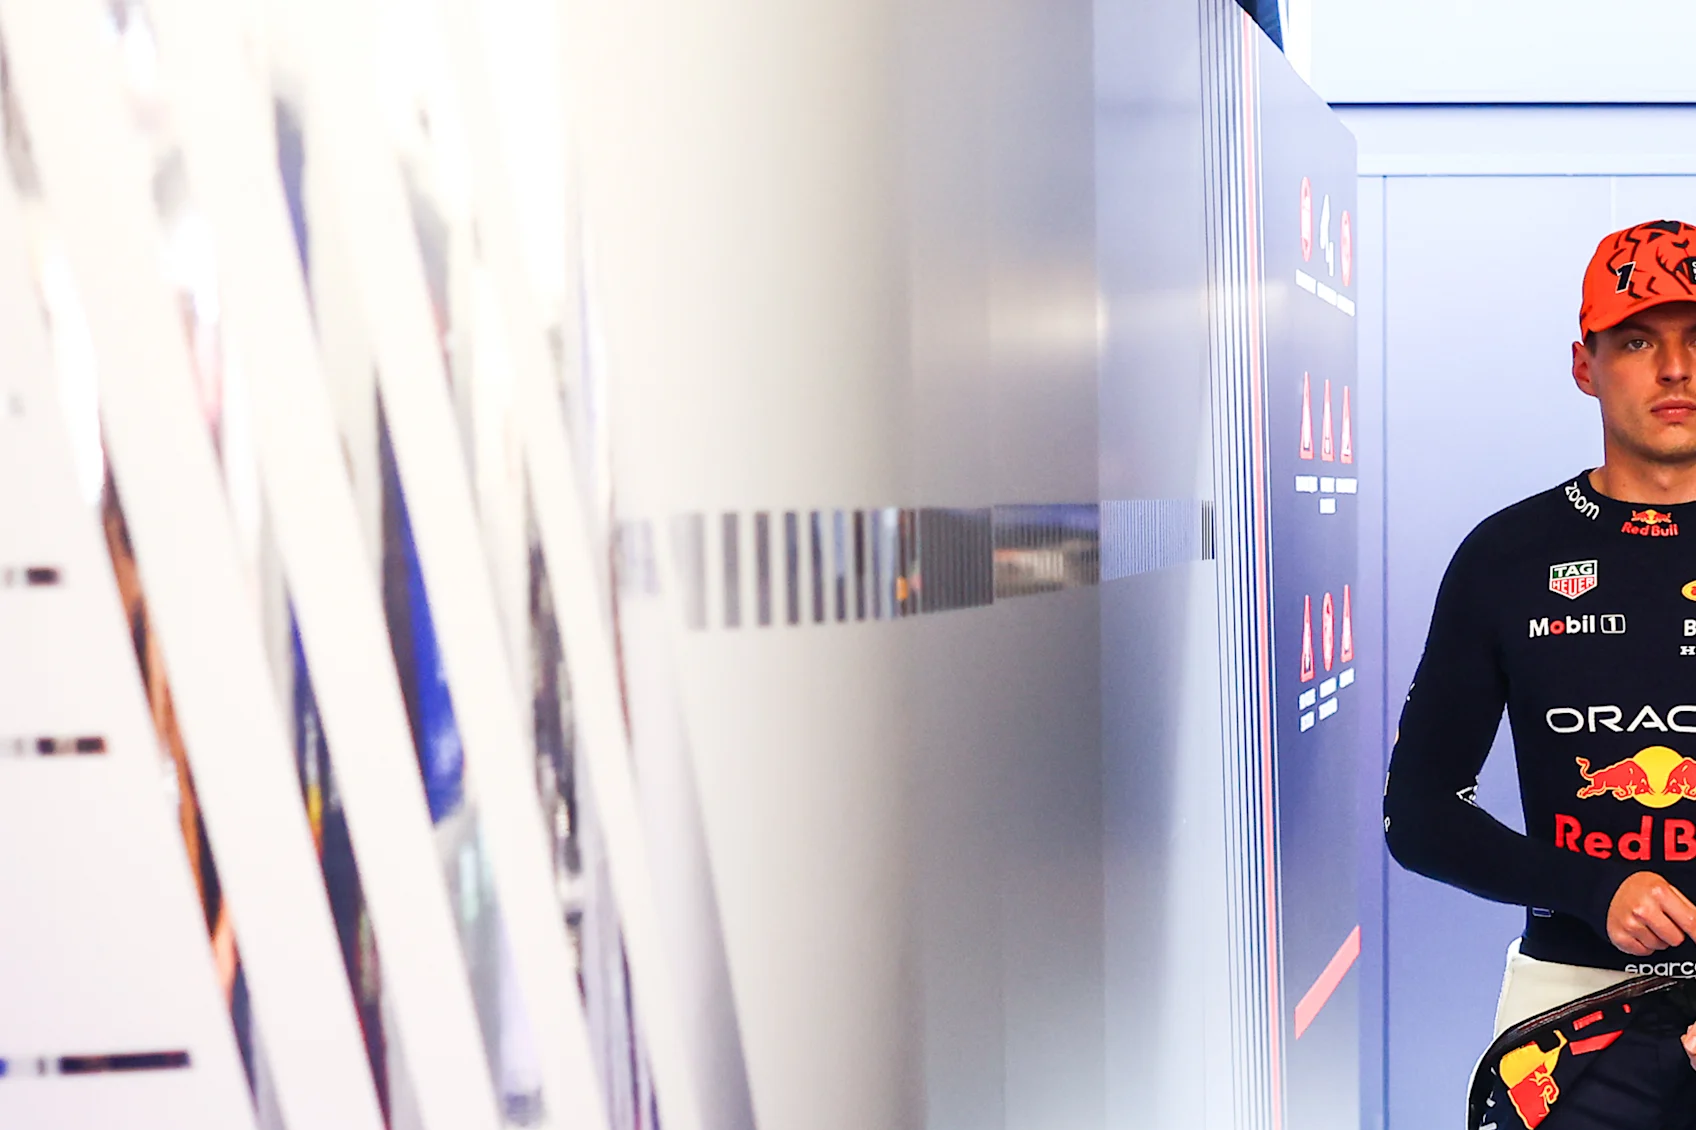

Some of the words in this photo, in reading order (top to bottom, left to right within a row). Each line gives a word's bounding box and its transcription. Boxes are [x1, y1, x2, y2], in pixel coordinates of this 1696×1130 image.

[1615, 261, 1636, 293] 1
[1564, 481, 1600, 520] zoom
[1621, 521, 1650, 536] Red
[1651, 523, 1679, 537] Bull
[1554, 563, 1593, 578] TAG
[1552, 577, 1594, 597] HEUER
[1529, 614, 1596, 638] Mobil
[1554, 813, 1654, 860] Red
